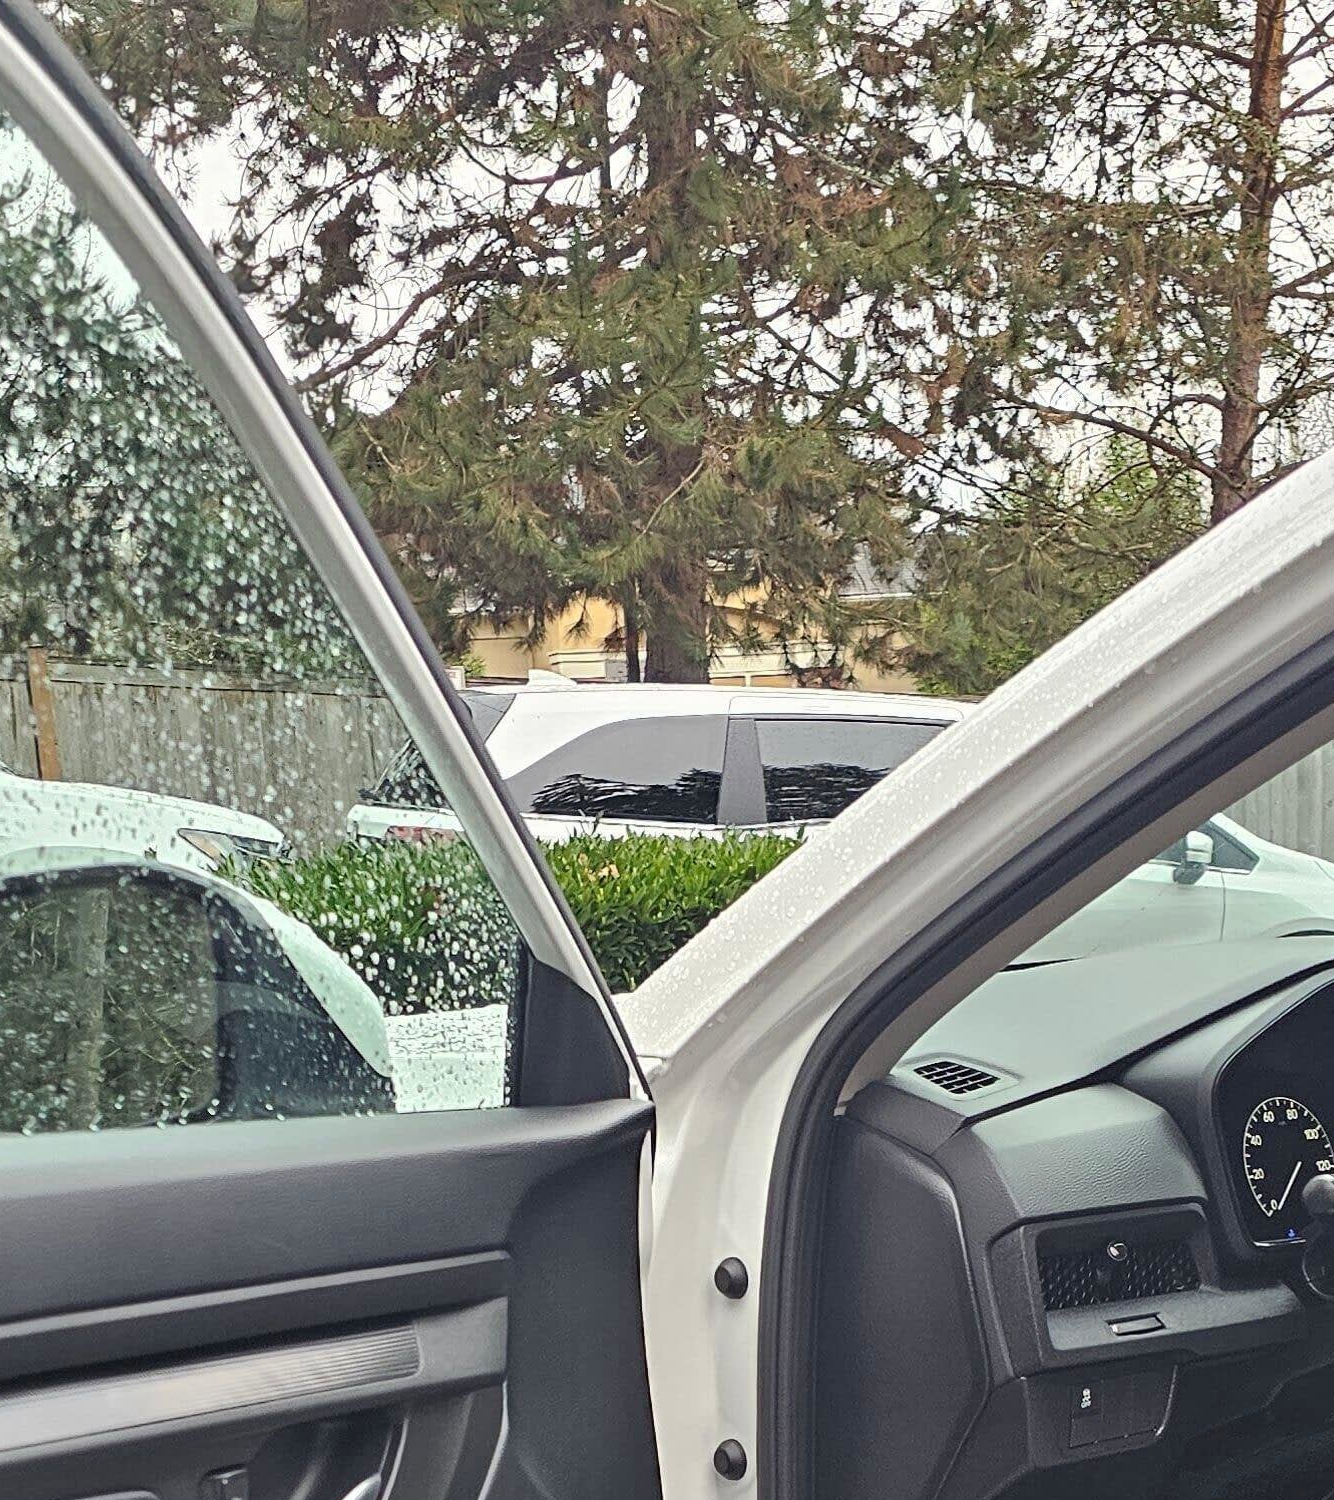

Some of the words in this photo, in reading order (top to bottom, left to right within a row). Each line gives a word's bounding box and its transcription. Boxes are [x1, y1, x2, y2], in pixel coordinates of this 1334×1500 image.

[1263, 1111, 1275, 1123] 60
[1286, 1109, 1298, 1120] 80
[1304, 1129, 1319, 1140] 100
[1250, 1135, 1262, 1146] 40
[1316, 1160, 1330, 1171] 120
[1252, 1168, 1264, 1179] 20
[1270, 1199, 1278, 1210] 0
